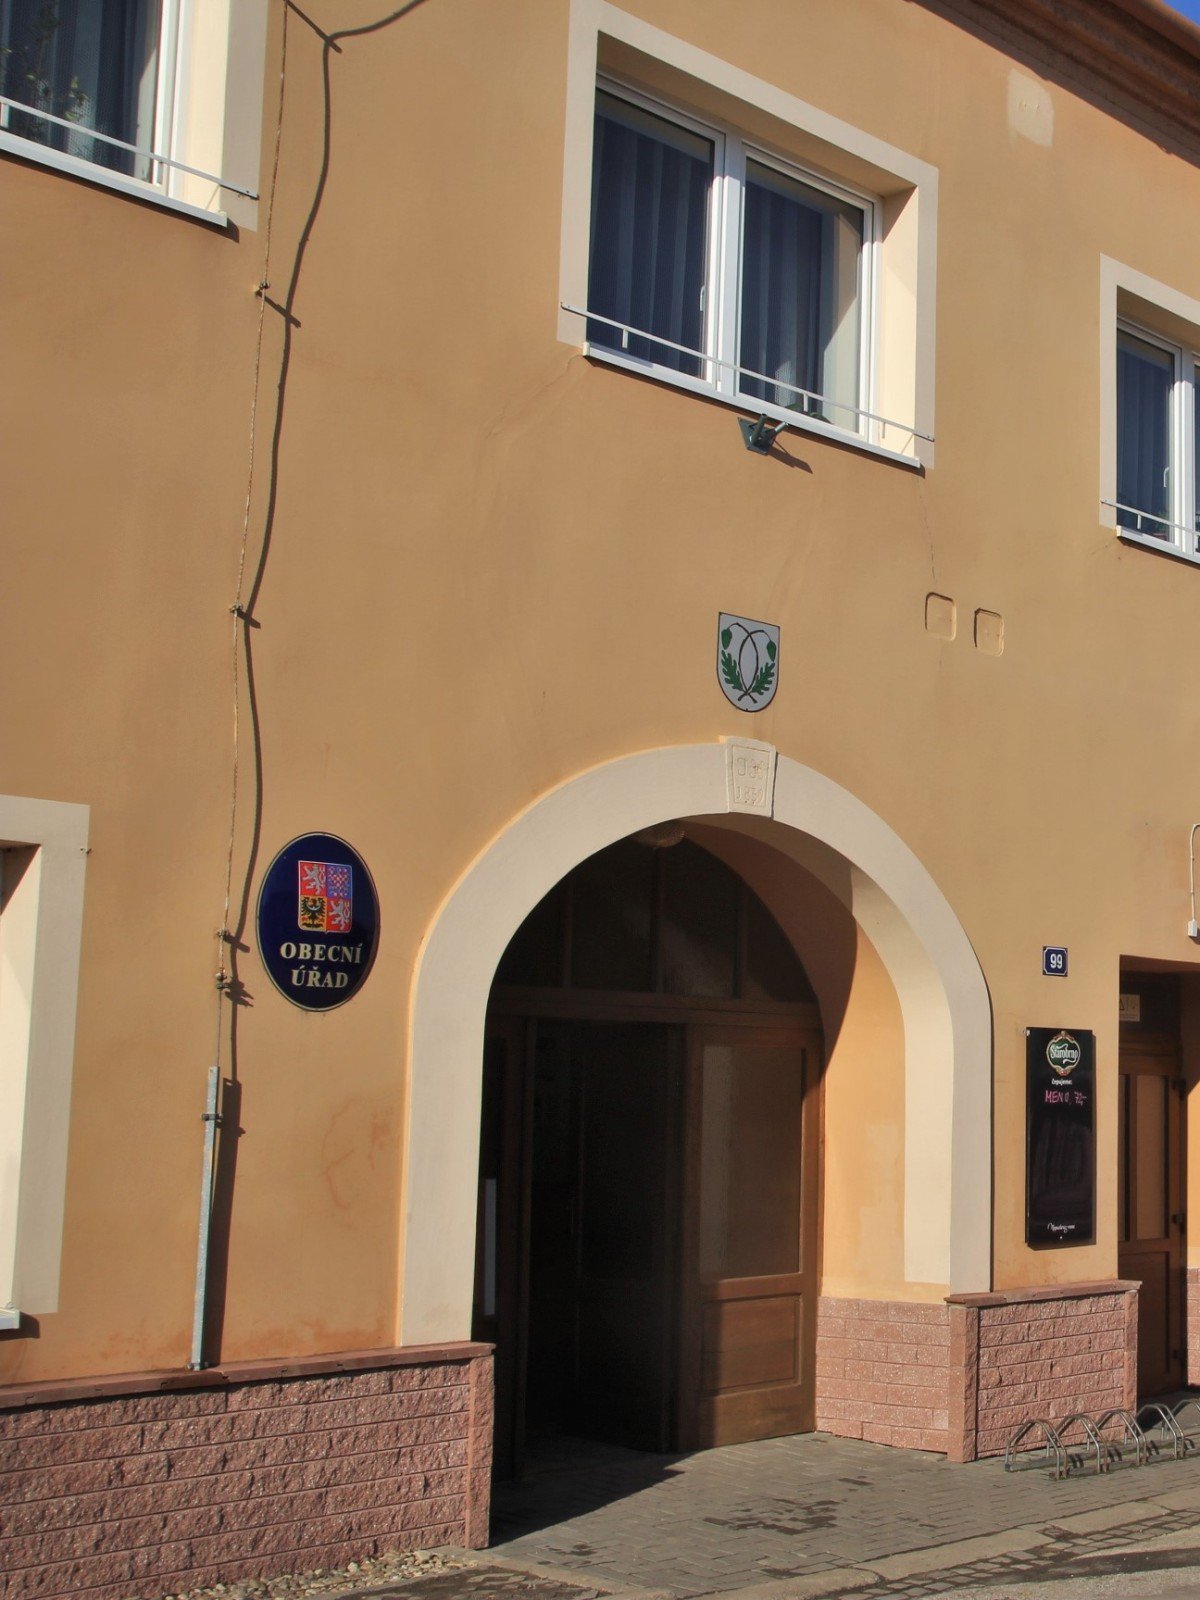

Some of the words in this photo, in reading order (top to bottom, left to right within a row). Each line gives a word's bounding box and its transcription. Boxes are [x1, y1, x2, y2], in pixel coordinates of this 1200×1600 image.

[280, 942, 362, 964] OBECNÍ
[1050, 953, 1063, 969] 99
[291, 965, 349, 988] ÚŘAD
[1050, 1043, 1079, 1065] Starobrno
